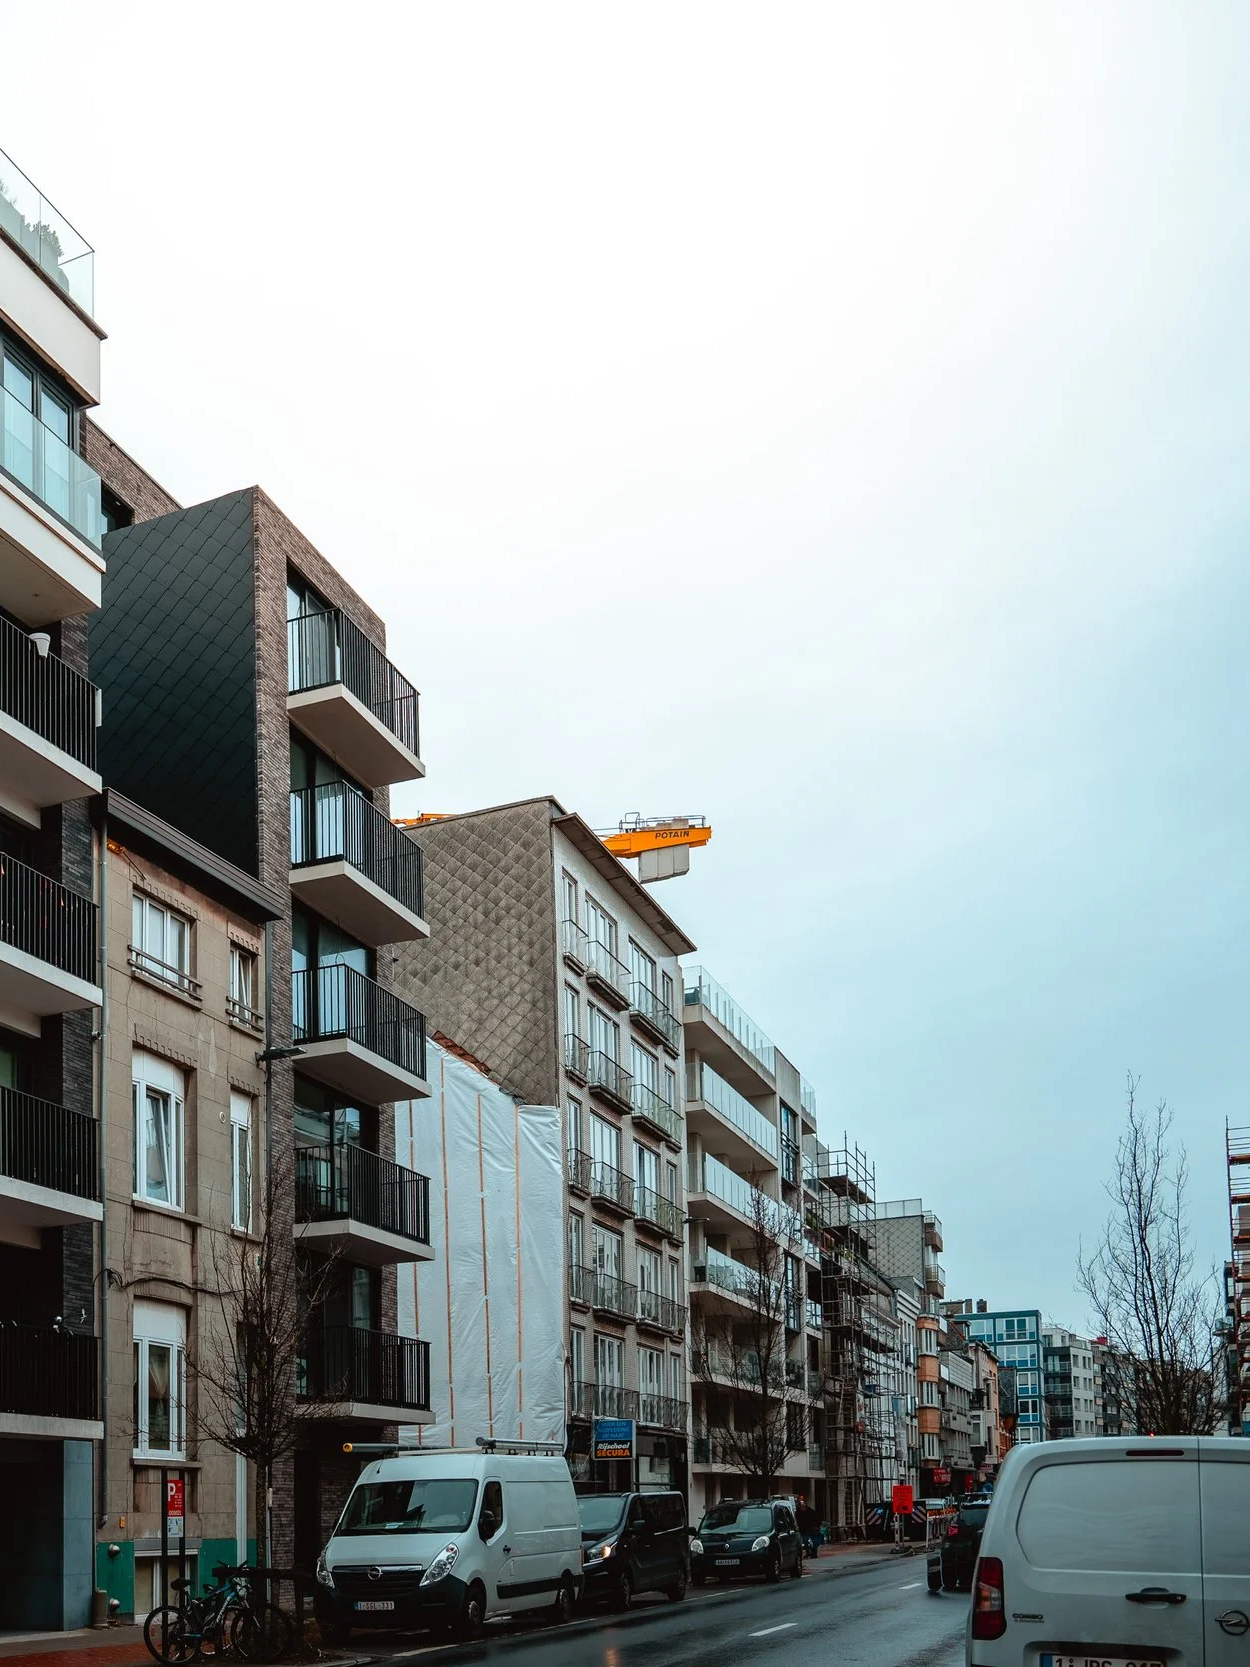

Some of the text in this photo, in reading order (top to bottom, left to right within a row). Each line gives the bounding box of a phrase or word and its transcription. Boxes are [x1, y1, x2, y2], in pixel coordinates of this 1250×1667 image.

[655, 830, 690, 839] POTAIN
[597, 1442, 631, 1450] Rijschool
[596, 1449, 631, 1457] SECURA
[167, 1482, 176, 1502] P
